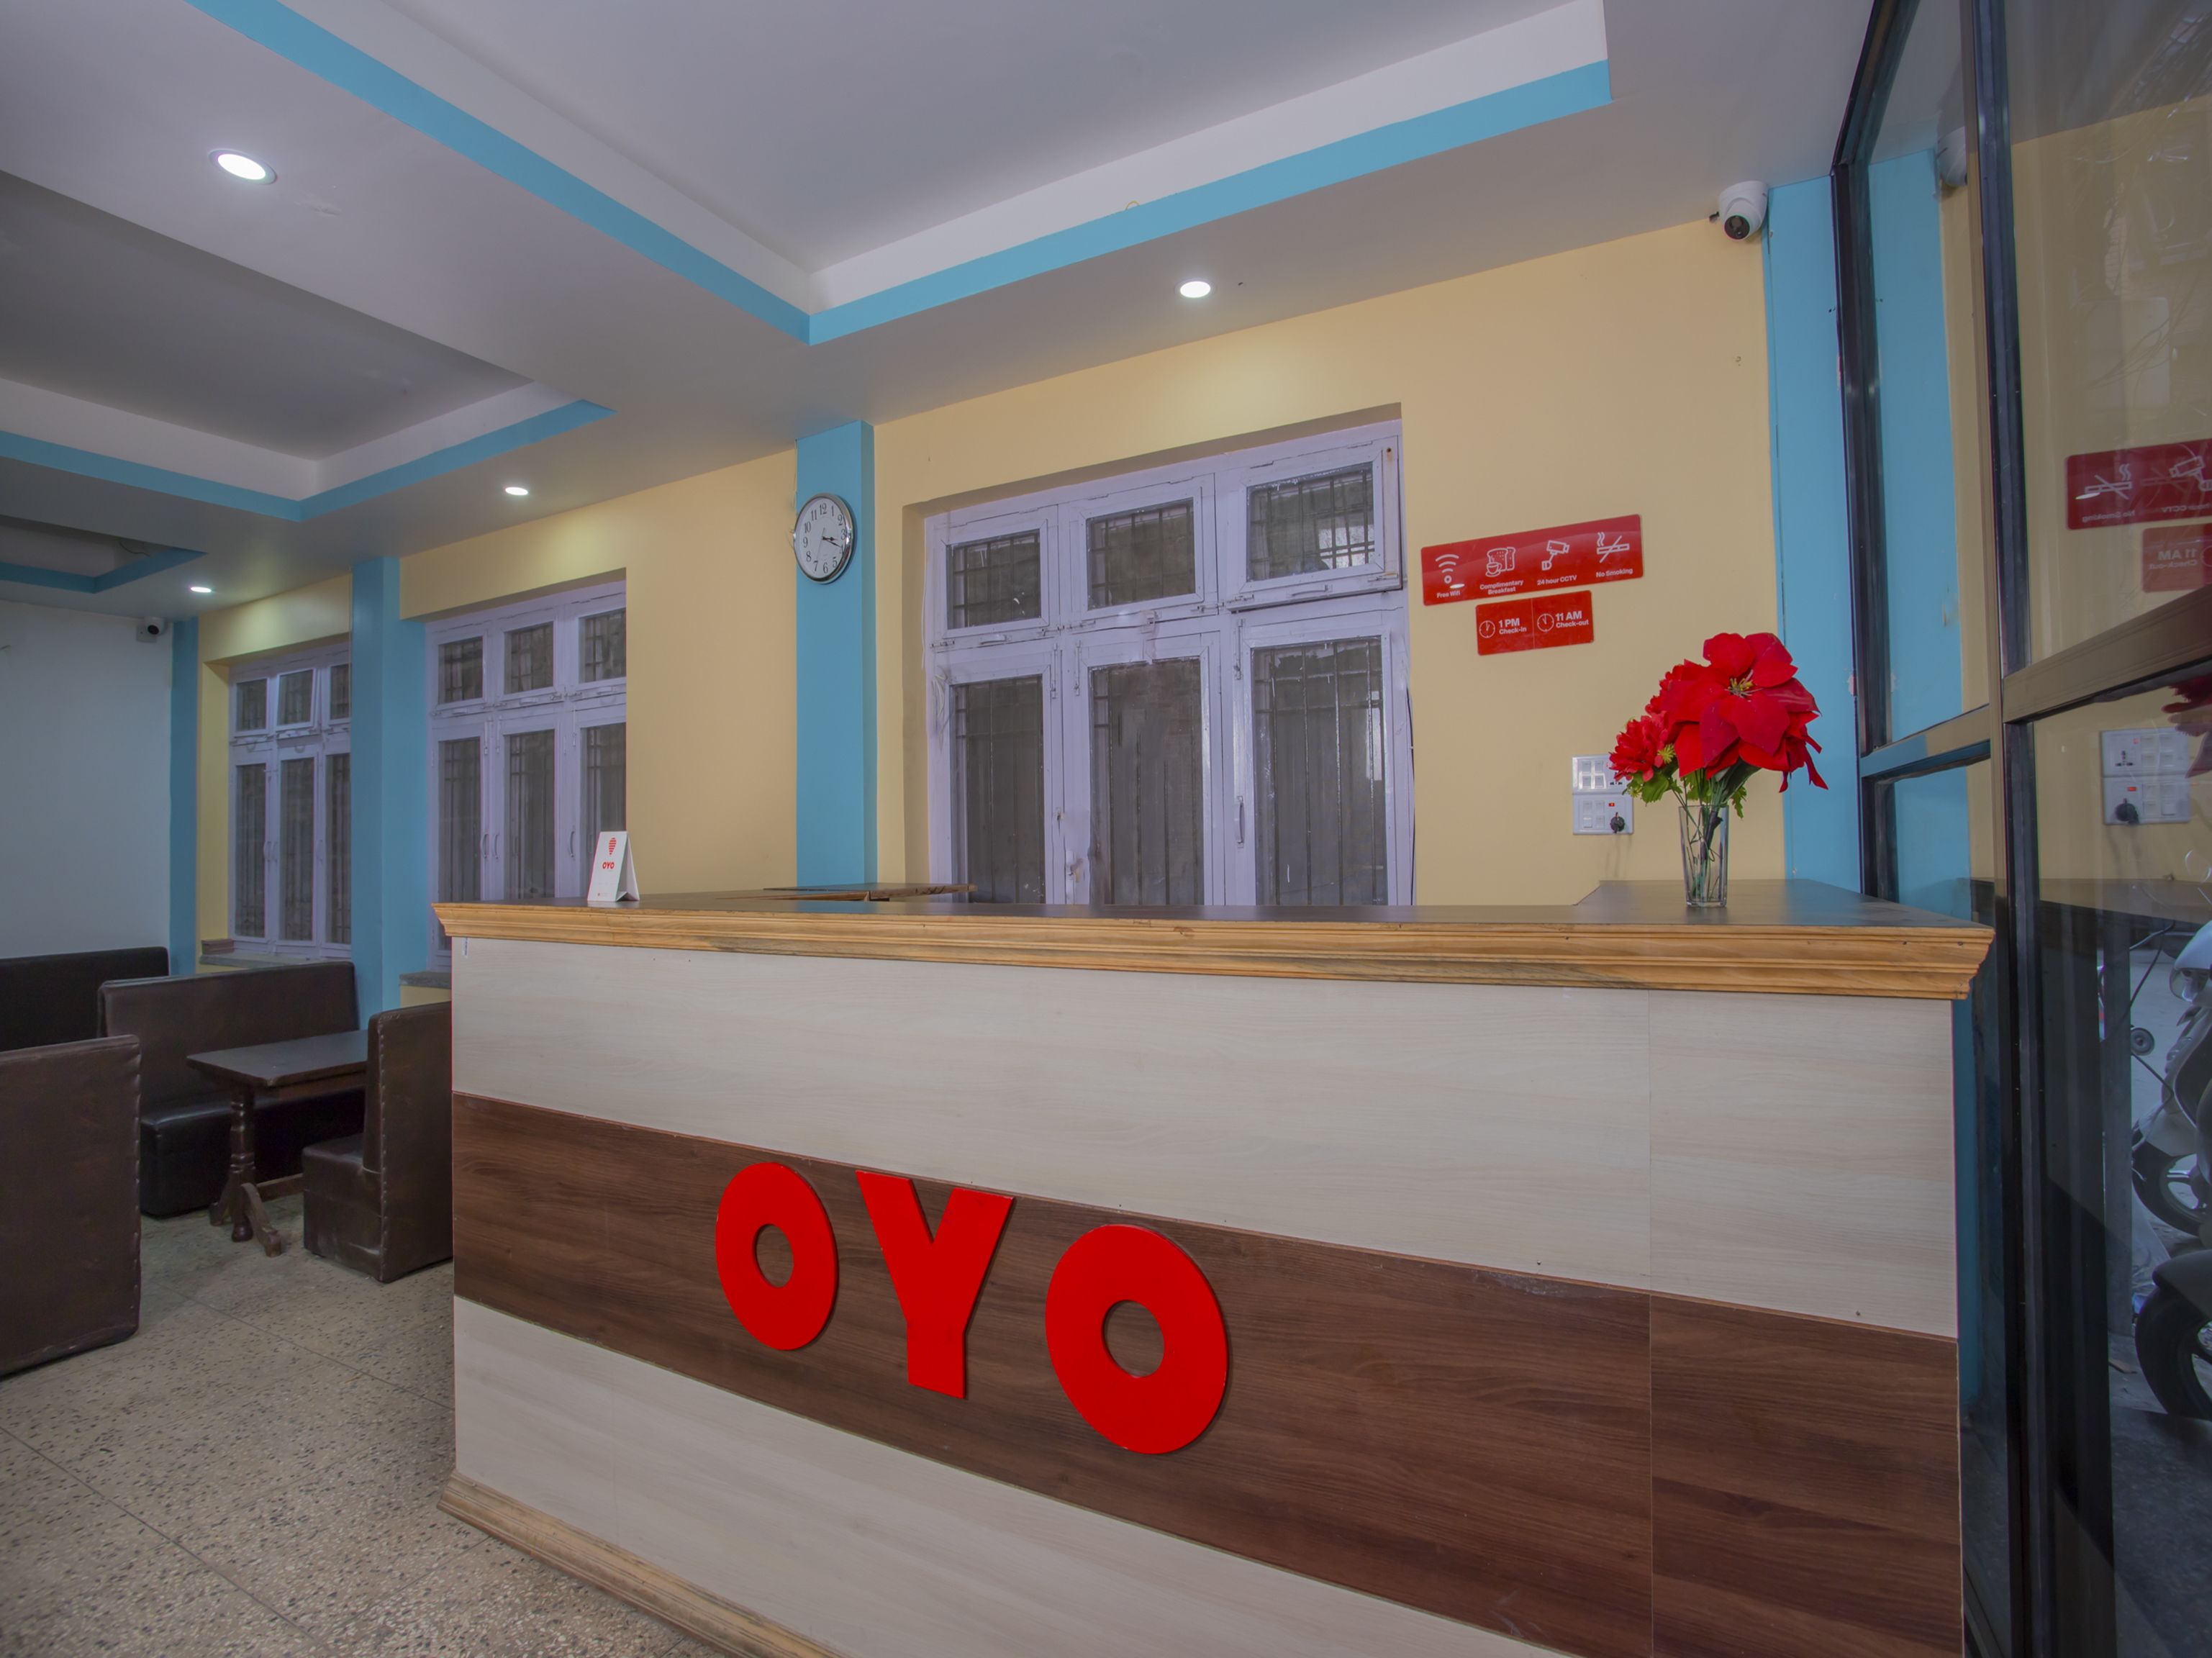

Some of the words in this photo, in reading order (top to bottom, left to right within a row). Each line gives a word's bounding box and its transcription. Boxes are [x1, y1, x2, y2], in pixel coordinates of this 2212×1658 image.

[820, 503, 827, 515] 12
[811, 509, 817, 521] 11
[838, 515, 843, 526] 2
[804, 521, 811, 533] 10
[803, 537, 808, 548] 9
[806, 551, 811, 562] 8
[833, 556, 837, 568] 5
[813, 561, 818, 571] 7
[823, 562, 828, 574] 6
[1479, 580, 1524, 590] Complimentary
[1487, 586, 1516, 595] Breakfast
[1565, 611, 1582, 620] AM
[1505, 618, 1520, 627] PM
[1556, 619, 1590, 628] Check-out
[715, 1161, 1230, 1455] OYO
